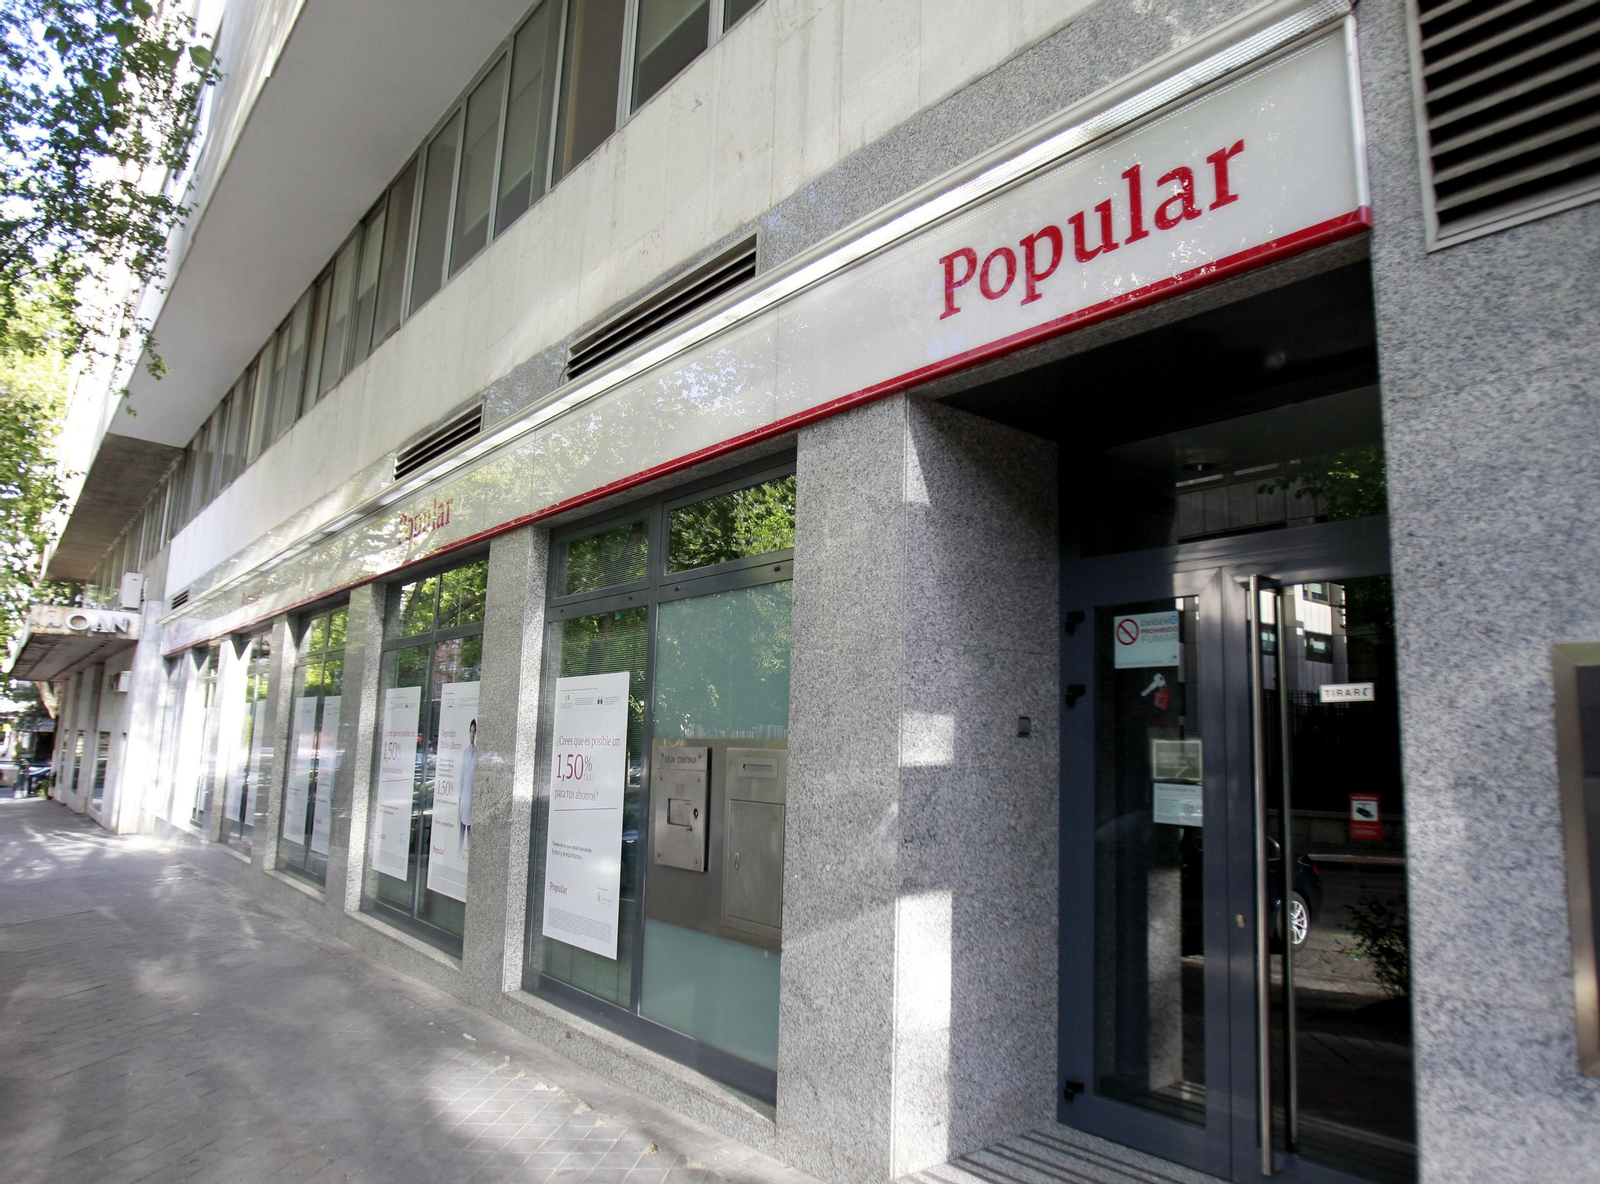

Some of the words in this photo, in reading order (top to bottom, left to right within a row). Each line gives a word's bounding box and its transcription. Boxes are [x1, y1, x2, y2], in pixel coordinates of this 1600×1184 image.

[939, 139, 1244, 320] Popular
[1140, 626, 1179, 635] PROHIBIDO
[1324, 688, 1361, 698] TIRAR
[557, 736, 573, 747] ¿Crees
[573, 737, 584, 748] que
[584, 737, 591, 746] es
[592, 735, 611, 748] posible
[612, 737, 621, 747] un
[677, 756, 697, 764] CONTINUA
[556, 753, 593, 782] 1,50%
[554, 789, 566, 800] para
[566, 789, 575, 799] tus
[575, 789, 599, 802] ahorros?
[550, 882, 567, 894] Popular
